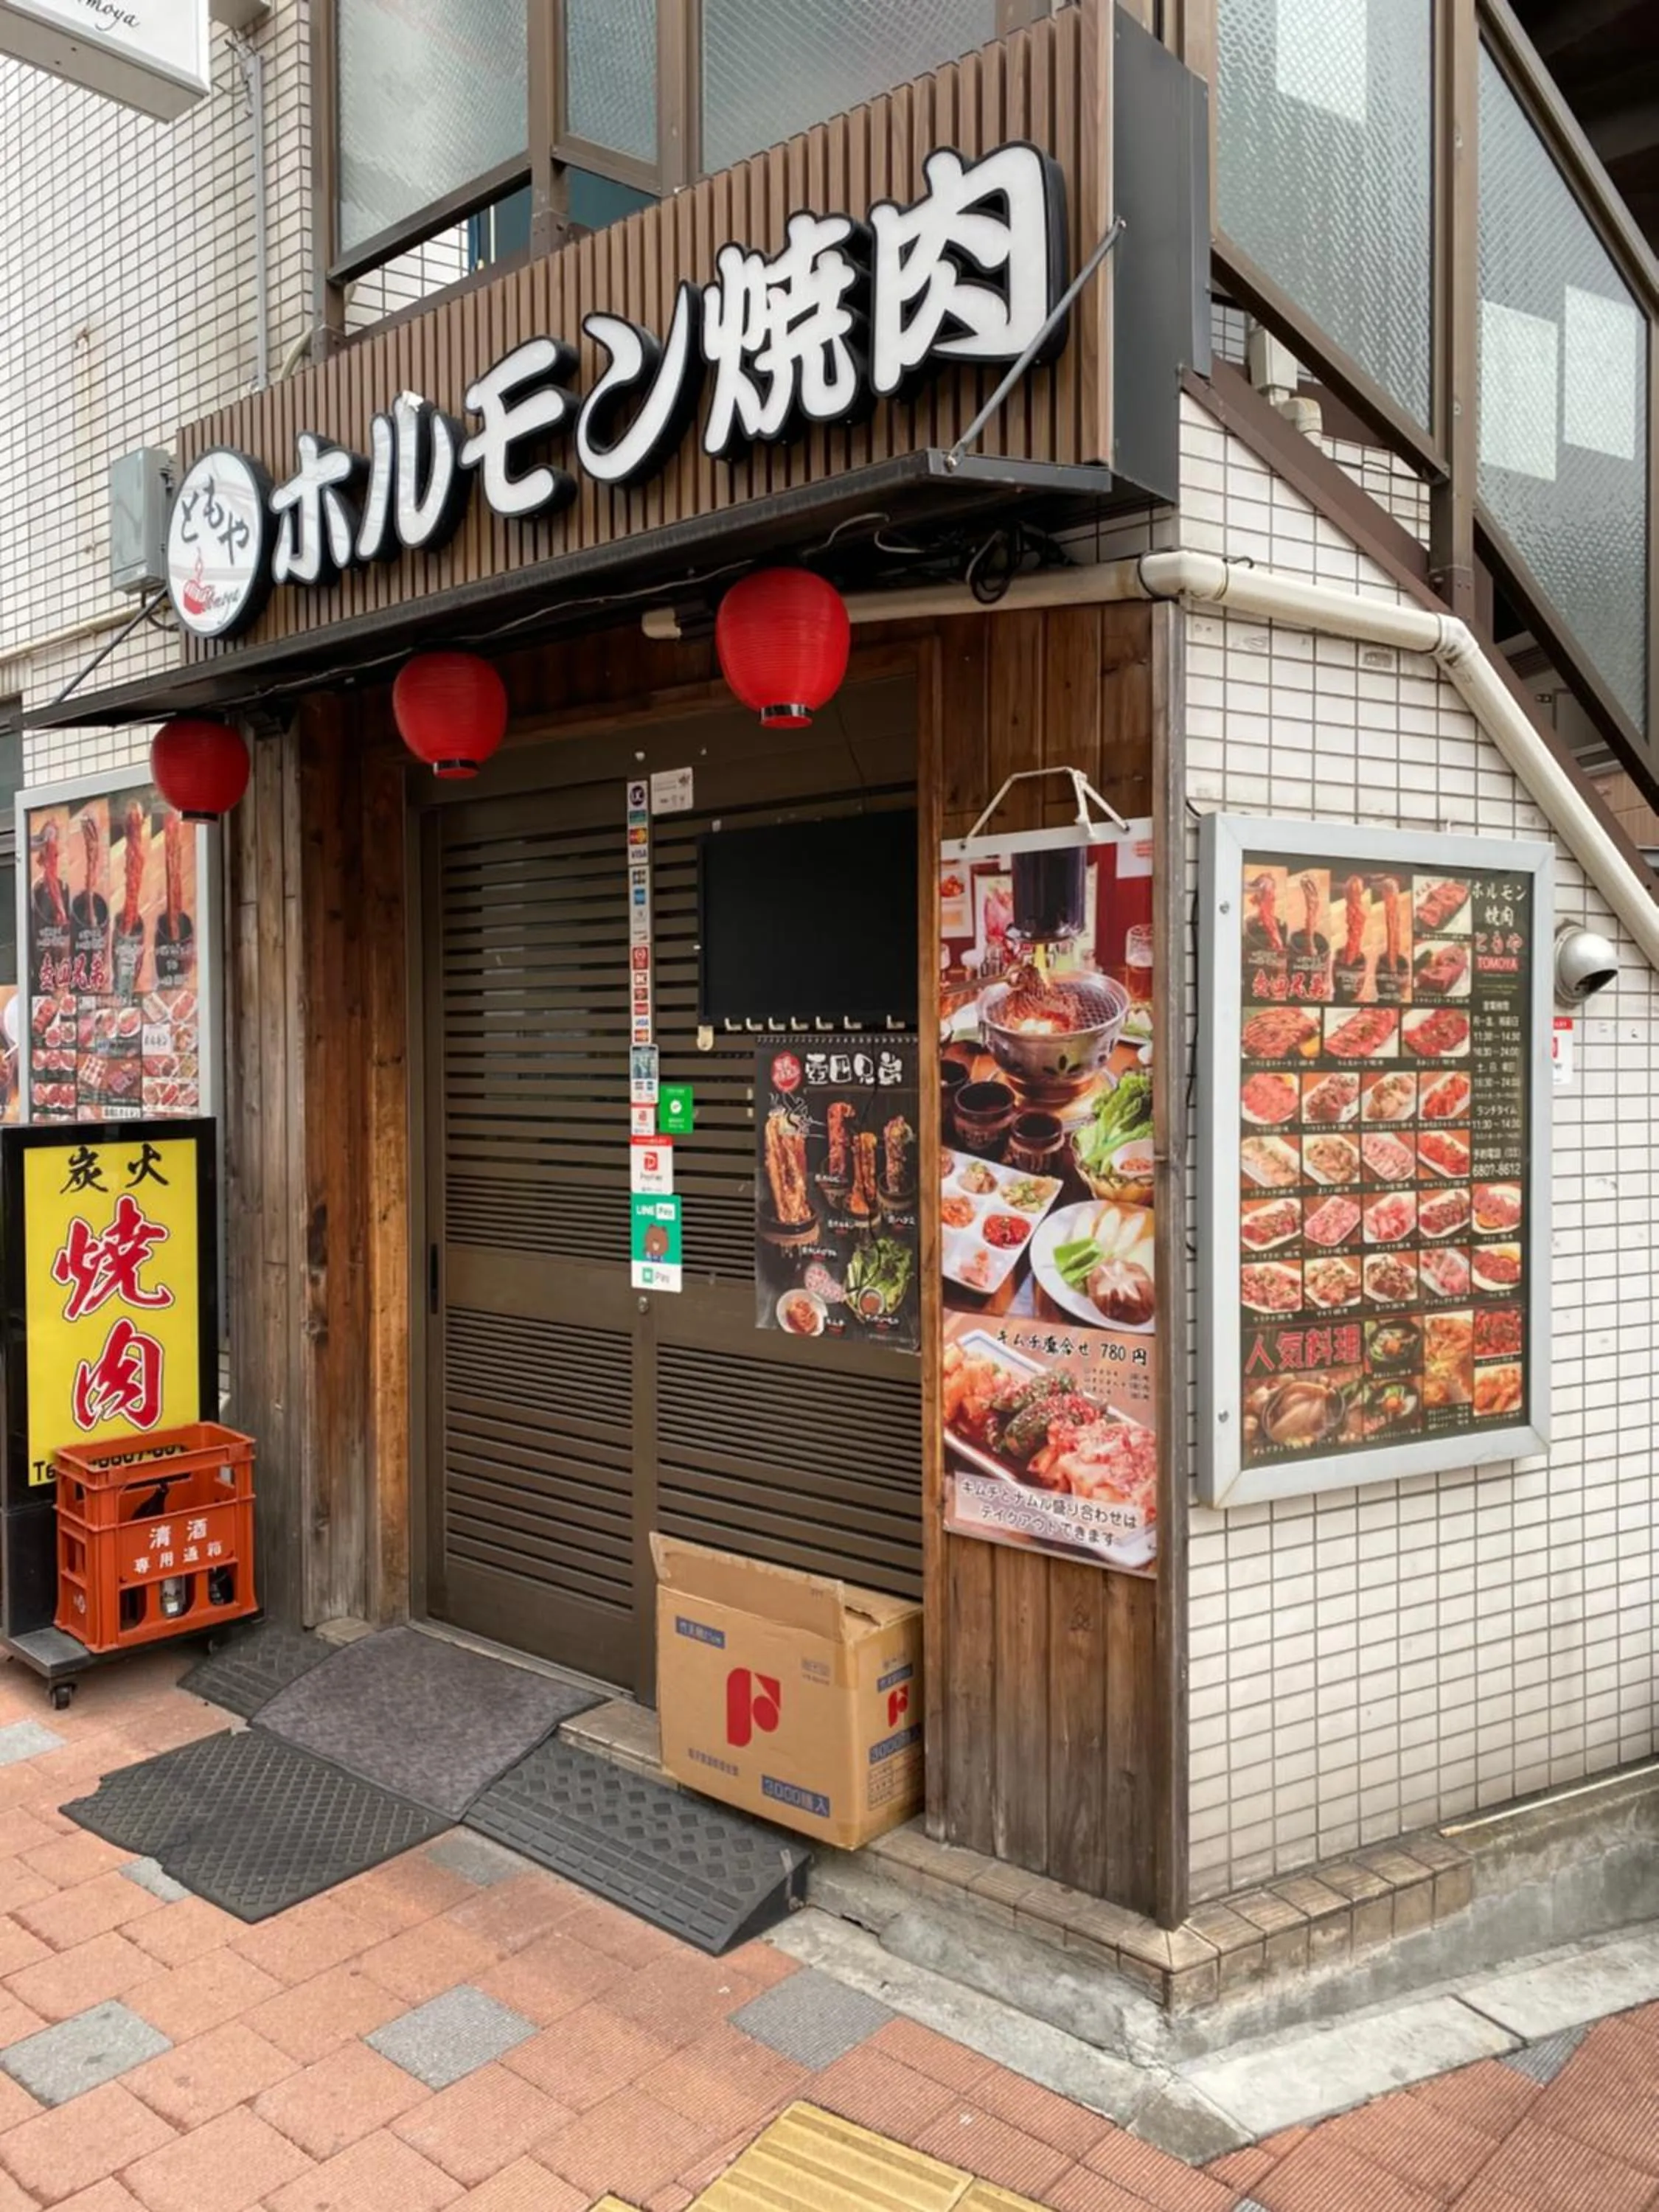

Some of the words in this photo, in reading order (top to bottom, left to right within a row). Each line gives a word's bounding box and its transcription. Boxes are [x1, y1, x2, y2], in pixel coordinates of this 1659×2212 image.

[270, 140, 1068, 584] ホルモン焼肉
[181, 474, 249, 566] ともや
[1472, 881, 1527, 901] ホルモン
[1477, 956, 1519, 973] TOMOYA
[60, 1144, 170, 1194] 炭火
[51, 1194, 175, 1432] 焼肉
[1244, 1326, 1362, 1374] 人気料理
